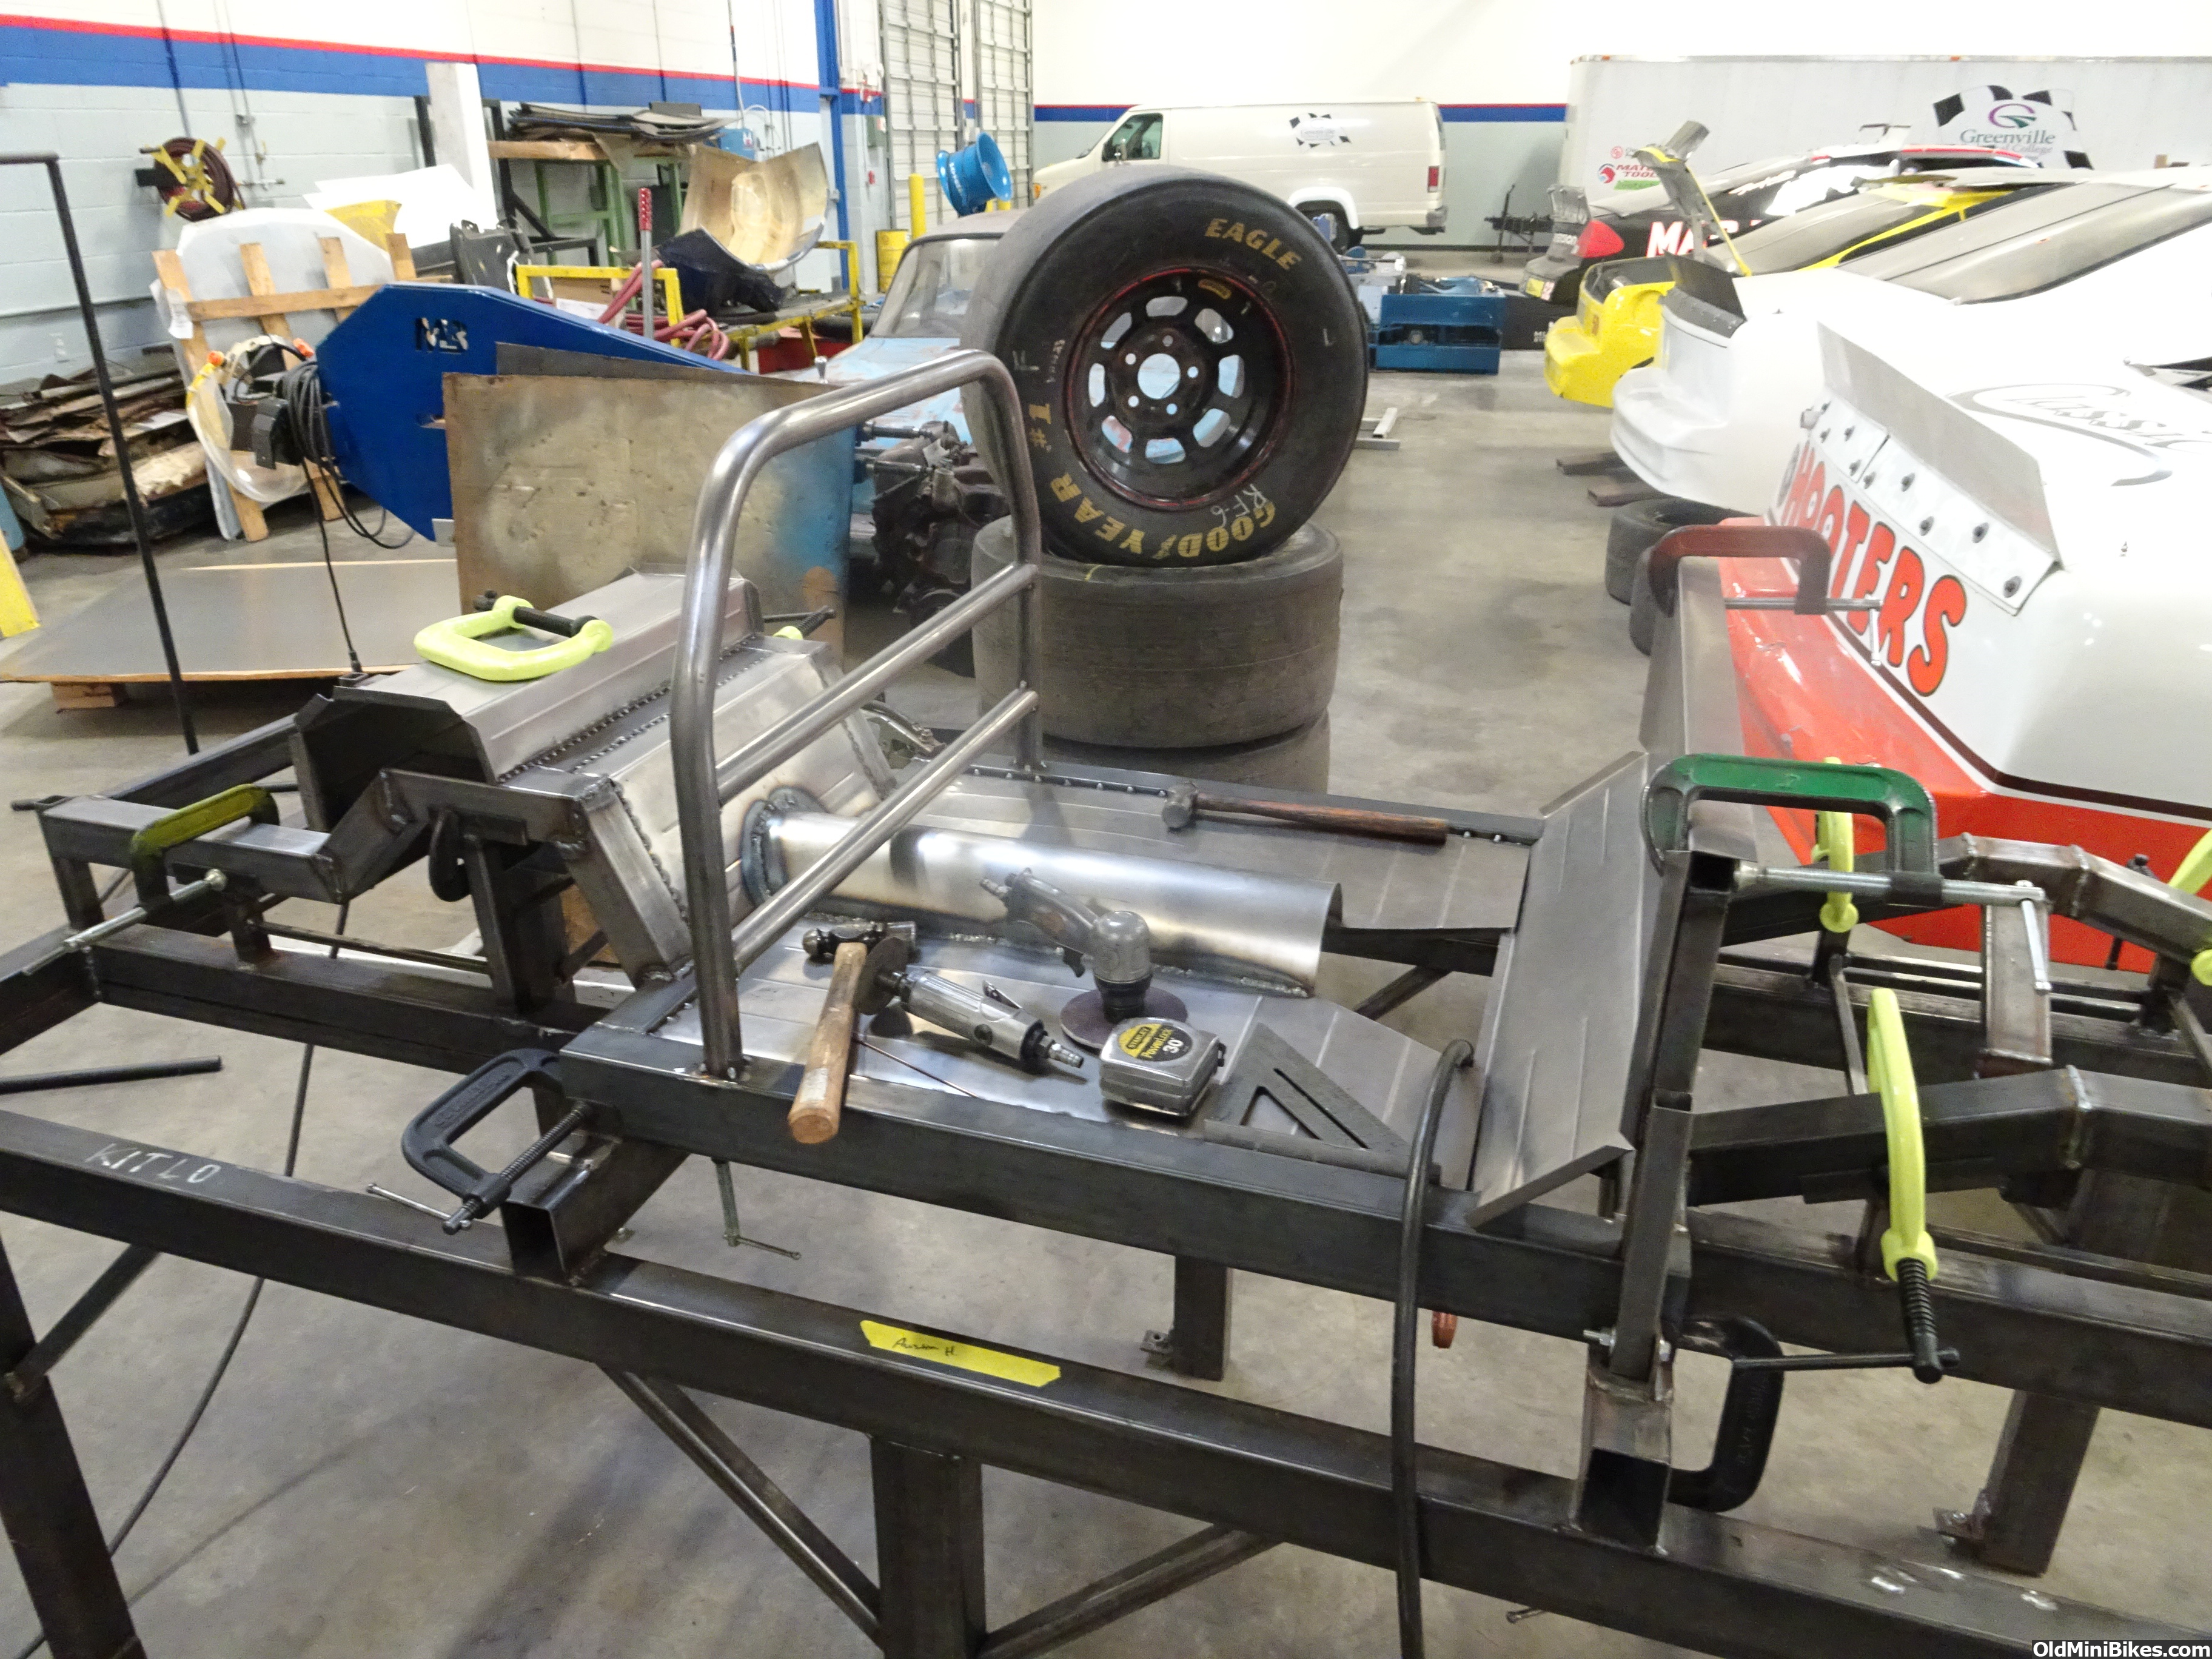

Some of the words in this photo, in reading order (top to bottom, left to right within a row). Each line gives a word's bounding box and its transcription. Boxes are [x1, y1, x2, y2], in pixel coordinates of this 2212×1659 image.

[1960, 129, 2056, 144] Greenville
[1205, 218, 1302, 270] EAGLE
[1780, 439, 1967, 697] HOOTERS
[1127, 1026, 1151, 1049] STANLEY
